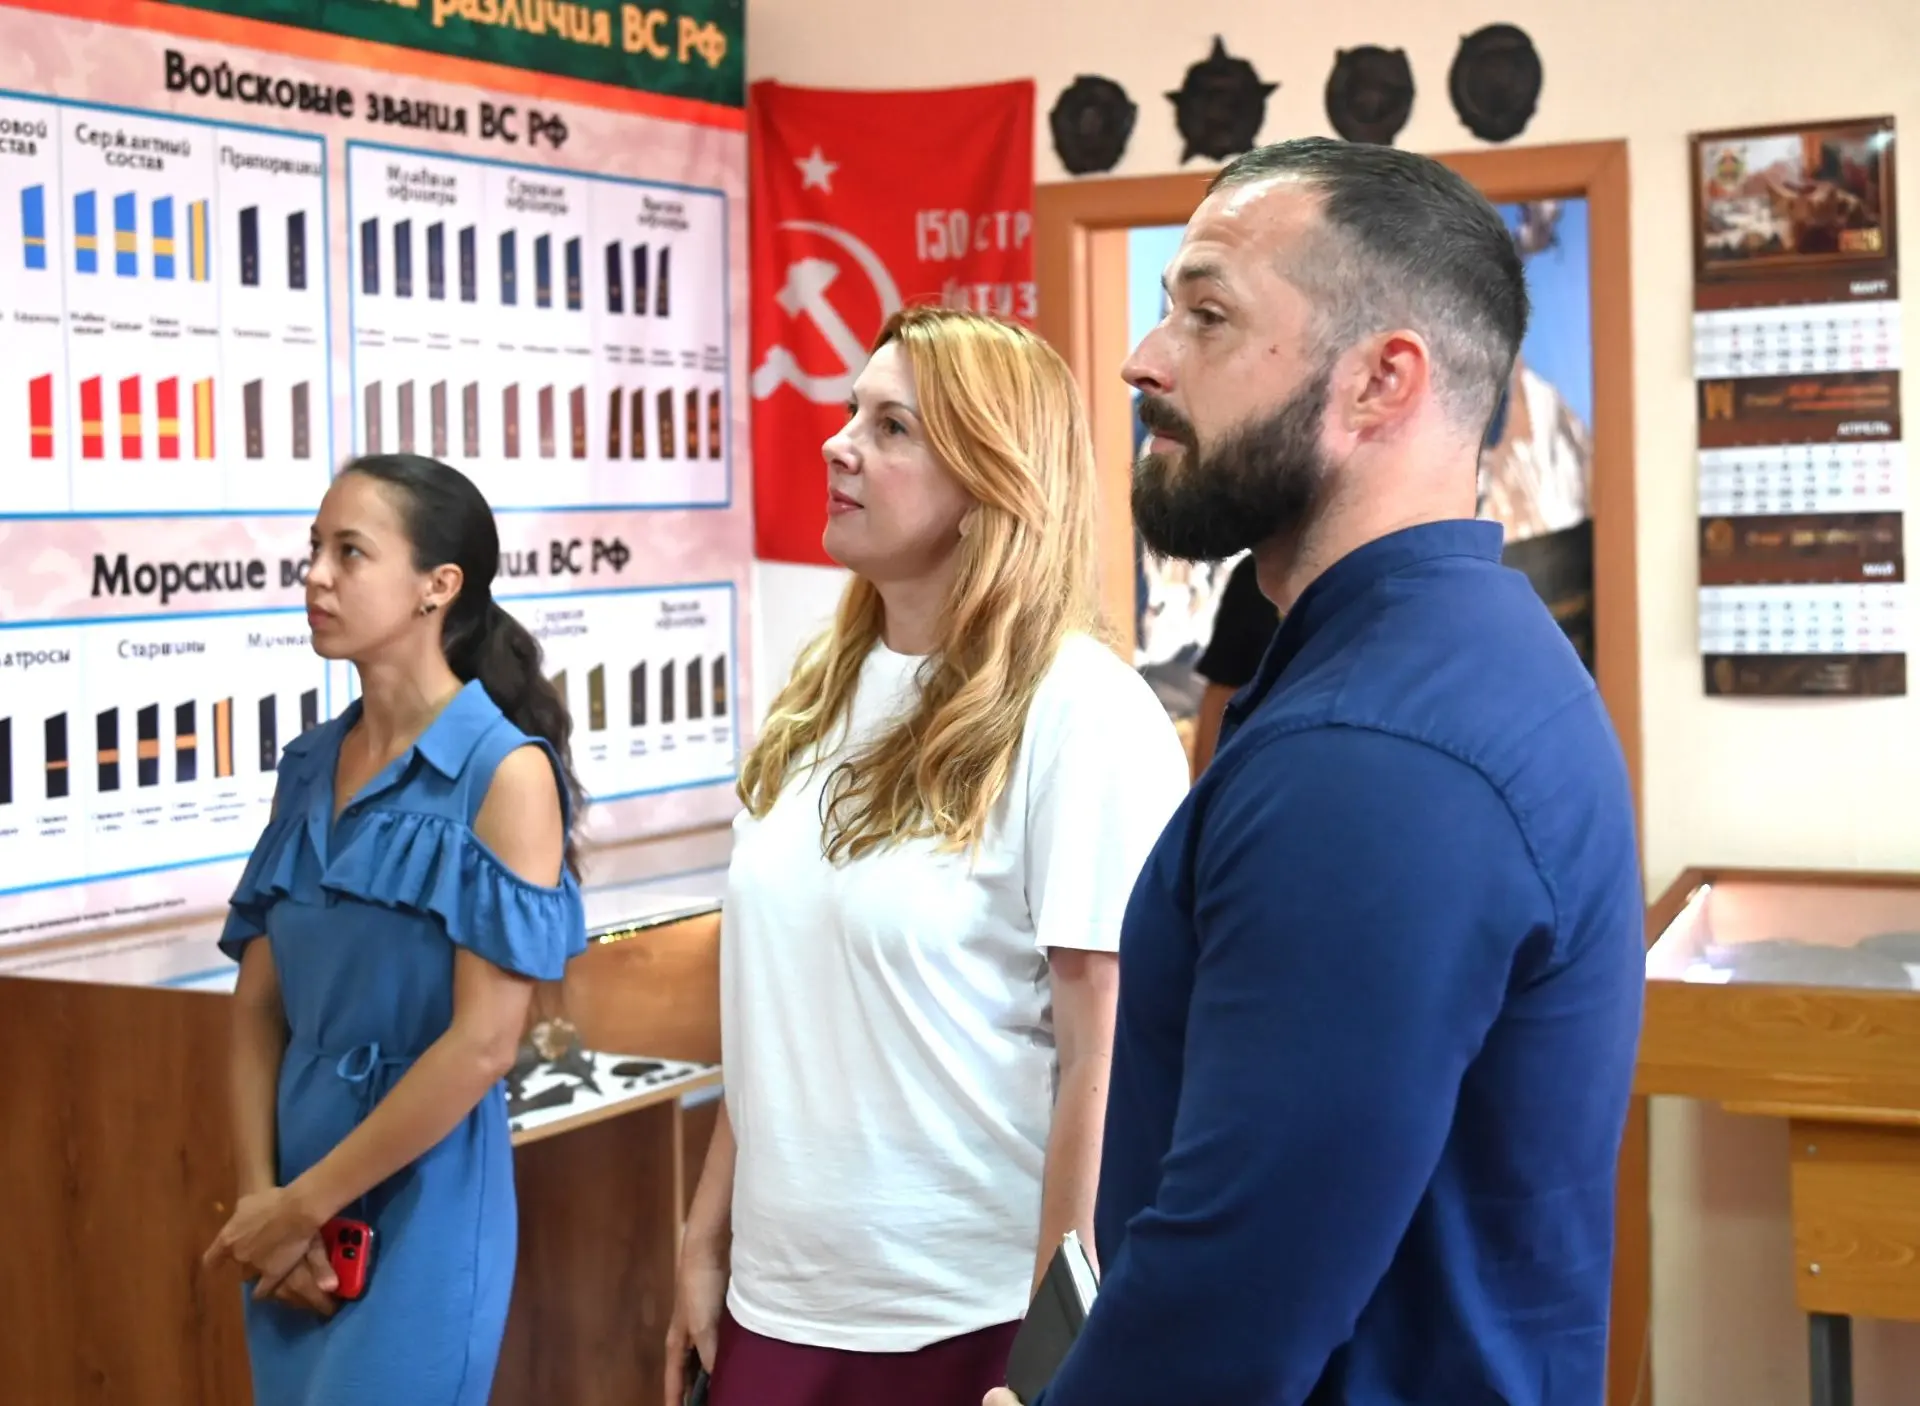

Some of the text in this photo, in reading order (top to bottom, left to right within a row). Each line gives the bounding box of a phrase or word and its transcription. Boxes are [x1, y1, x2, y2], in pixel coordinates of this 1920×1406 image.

[621, 3, 670, 59] ВС
[677, 15, 727, 68] РФ
[164, 48, 569, 148] Войсковые звания ВС РФ
[104, 150, 164, 171] состав
[916, 208, 968, 262] 150
[91, 554, 266, 605] Морские
[550, 538, 582, 576] ВС
[591, 536, 631, 576] РФ
[0, 649, 70, 672] атросы
